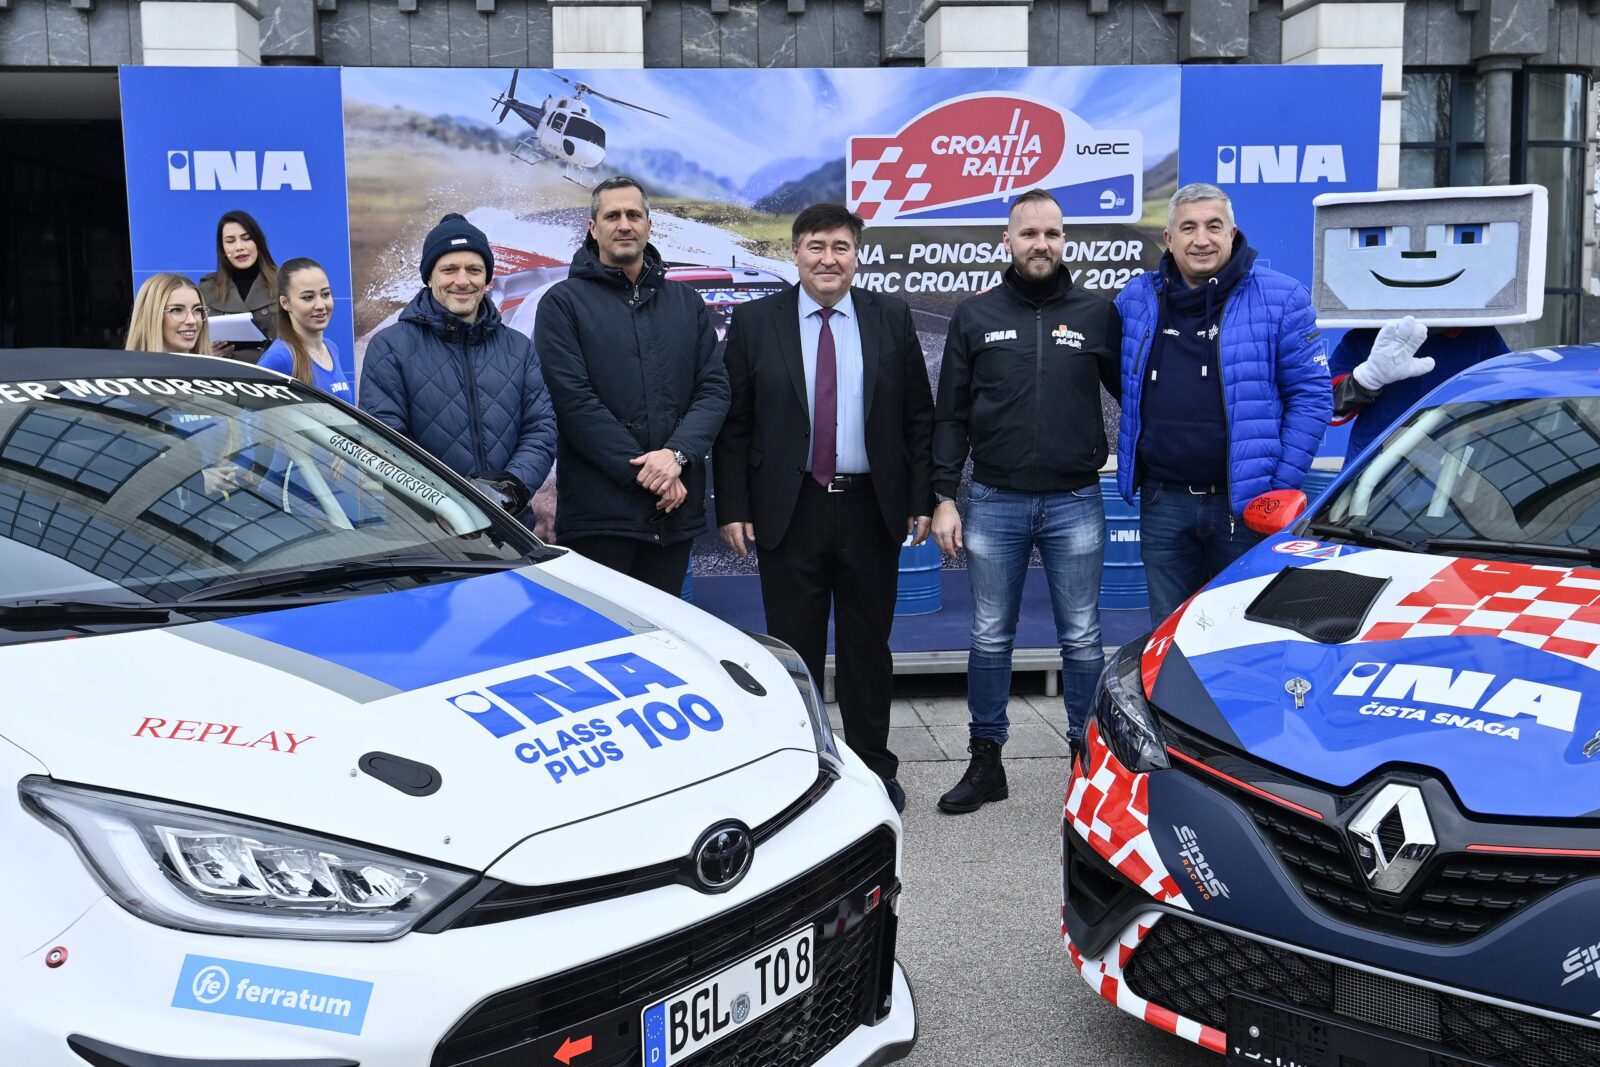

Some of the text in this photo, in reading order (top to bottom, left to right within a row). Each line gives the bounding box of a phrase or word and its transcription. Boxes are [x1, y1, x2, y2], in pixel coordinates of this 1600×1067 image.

[931, 134, 1042, 156] CROATIA
[1076, 142, 1130, 155] WRC
[961, 156, 1041, 177] RALLY
[858, 244, 885, 265] NA
[908, 242, 1013, 264] PONOSA
[1061, 240, 1143, 262] ONZOR
[904, 270, 1004, 293] CROATIA
[0, 377, 304, 403] ER MOTORSPORT
[329, 434, 447, 506] GASSNER MOTORSPORT
[130, 716, 317, 755] REPLAY
[615, 693, 724, 750] 100
[1358, 700, 1521, 740] ČISTA SNAGA
[514, 718, 613, 764] CLASS
[544, 740, 625, 785] PLUS
[1182, 858, 1210, 900] RACING
[235, 977, 353, 1017] ferratum
[669, 982, 731, 1056] BGL
[795, 936, 810, 984] 8
[651, 1046, 660, 1064] D
